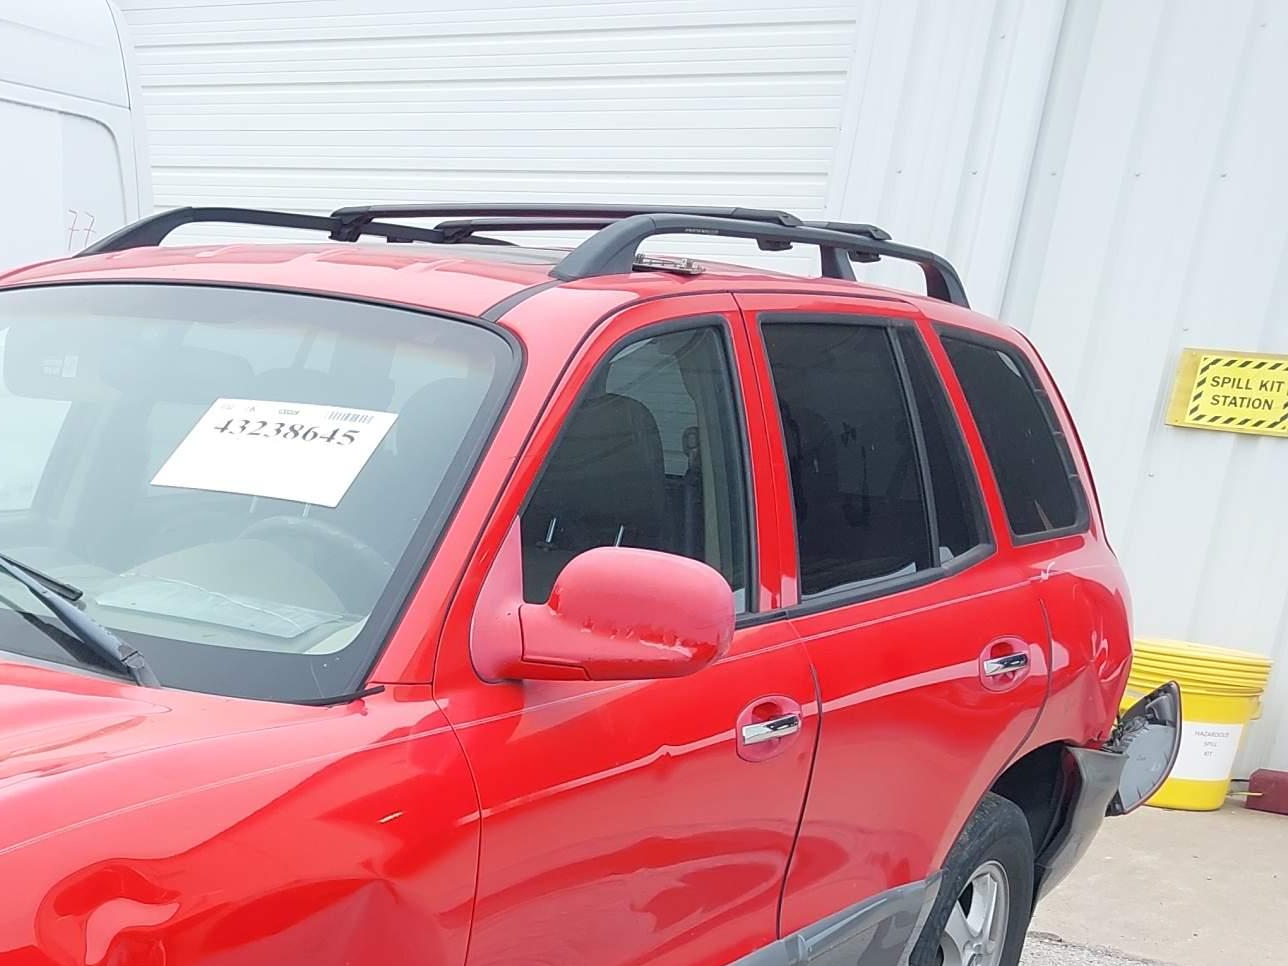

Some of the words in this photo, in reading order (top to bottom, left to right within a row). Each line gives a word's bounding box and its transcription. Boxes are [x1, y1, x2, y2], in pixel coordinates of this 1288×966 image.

[1210, 376, 1253, 390] SPILL
[1259, 380, 1285, 392] KIT
[1210, 395, 1273, 410] STATION
[213, 418, 361, 446] 43238645
